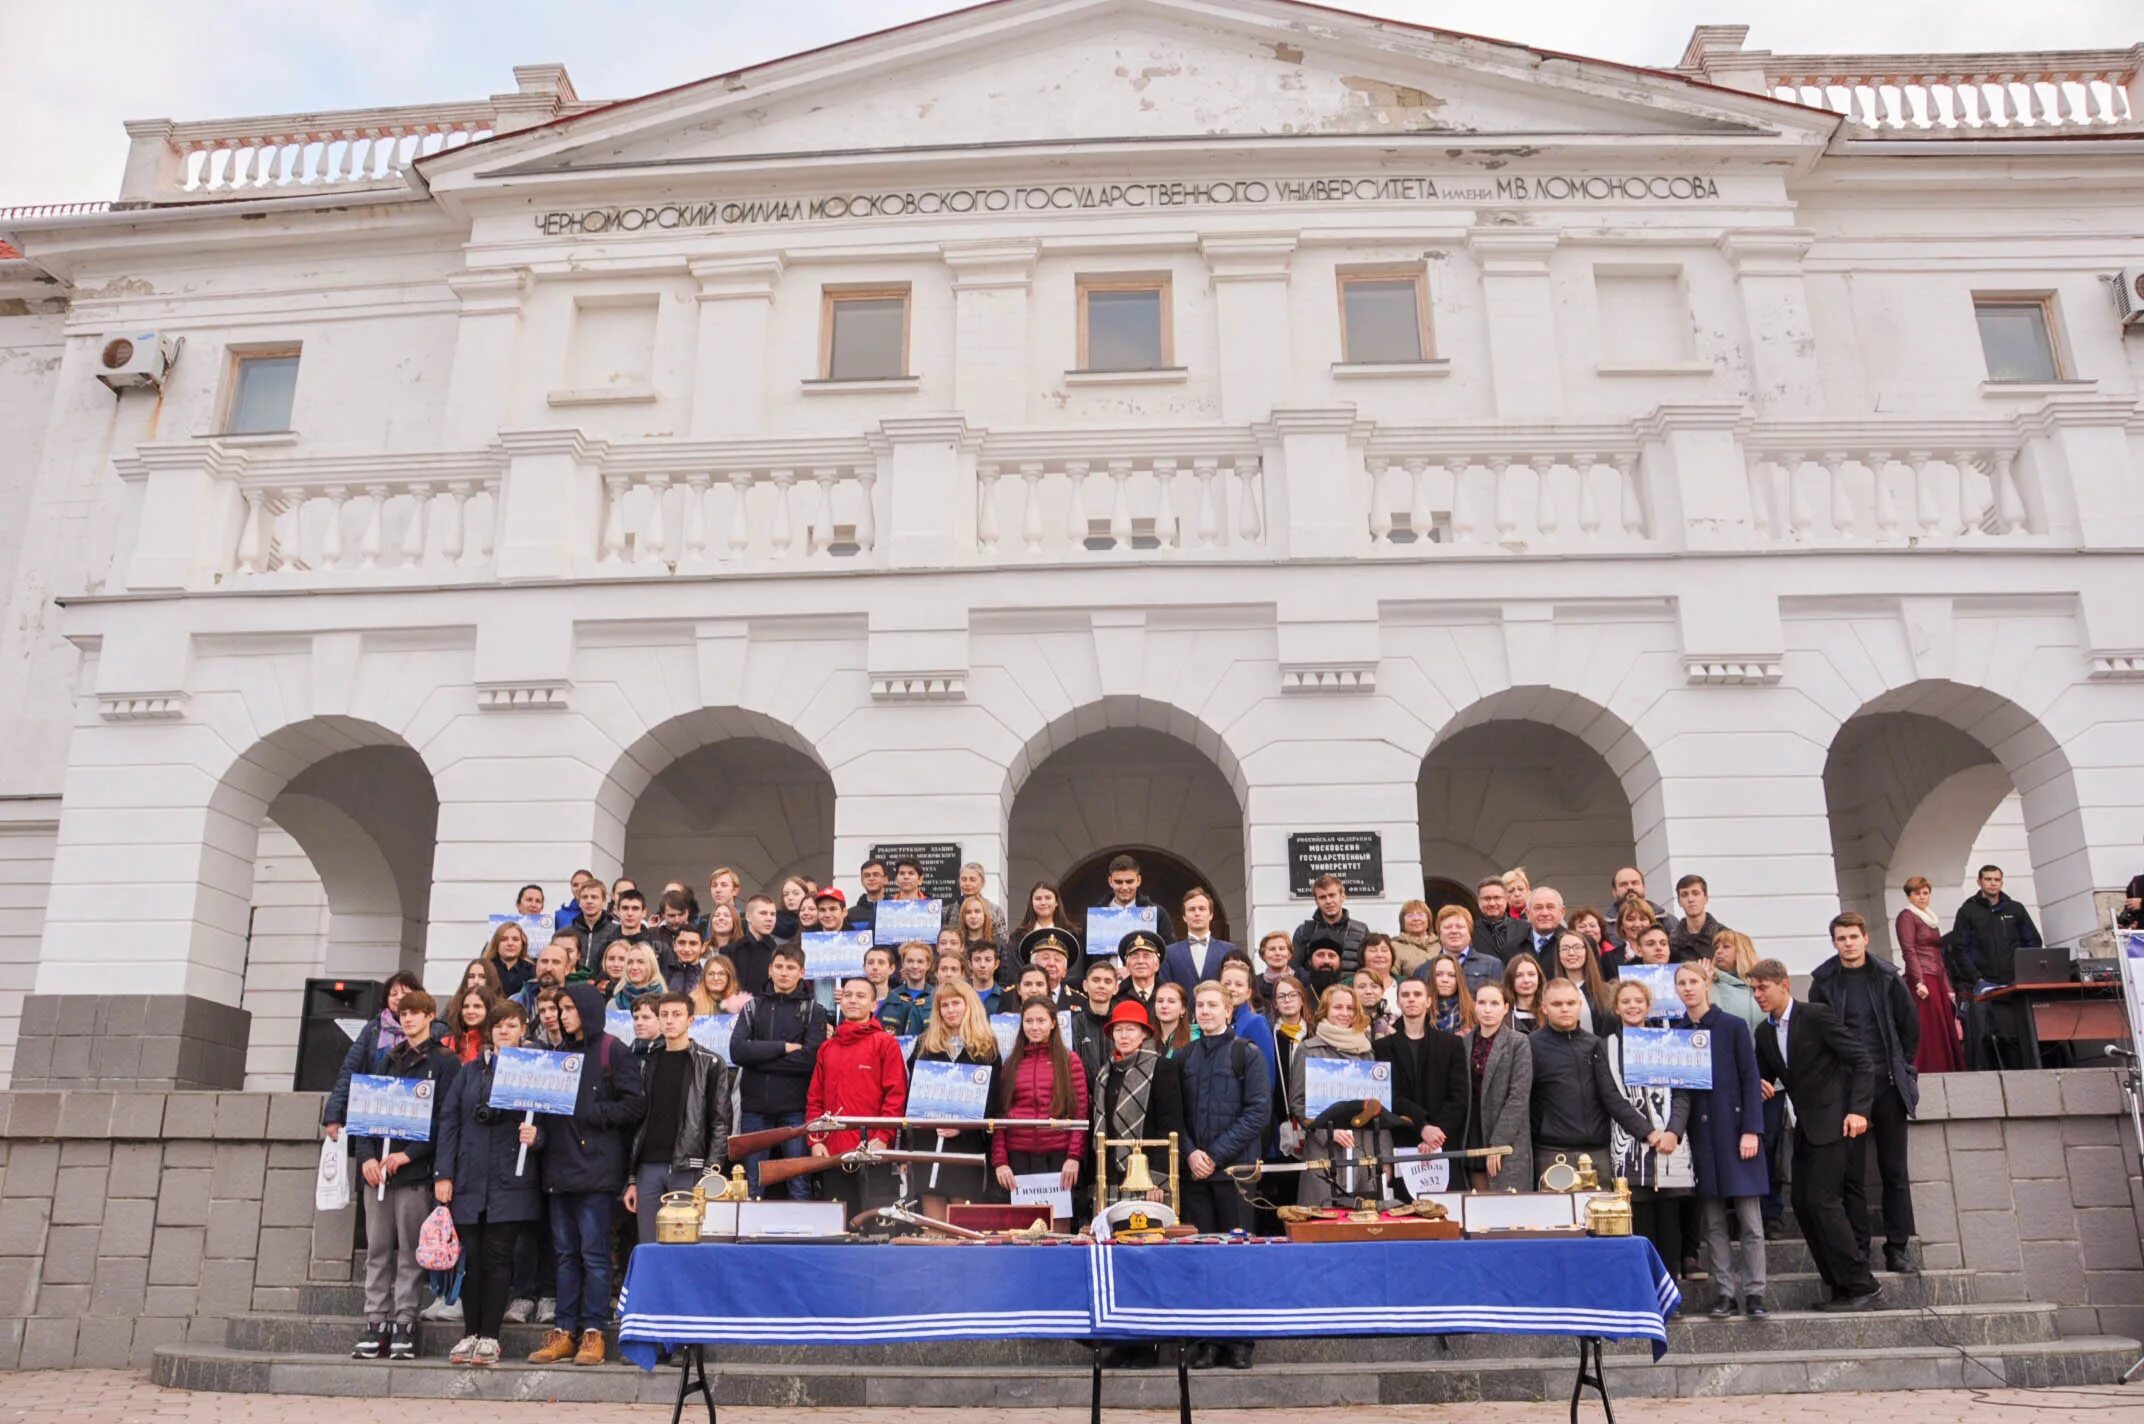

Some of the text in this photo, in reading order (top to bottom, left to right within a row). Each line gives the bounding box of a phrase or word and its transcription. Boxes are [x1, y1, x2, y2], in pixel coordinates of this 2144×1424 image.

[534, 202, 717, 236] ЧЕРНОМОРСКИЙ
[721, 200, 804, 224] ФИЛИАЛ
[808, 188, 1010, 220] МОСКОВСКОГО
[1014, 181, 1270, 211] ГОСУДАРСТВЕННОГО
[1274, 178, 1438, 202] УНИВЕРСИТЕТА
[1534, 176, 1720, 200] ЛОМОНОСОВА
[1299, 853, 1371, 861] ГОСУДАРСТВЕННЫЙ
